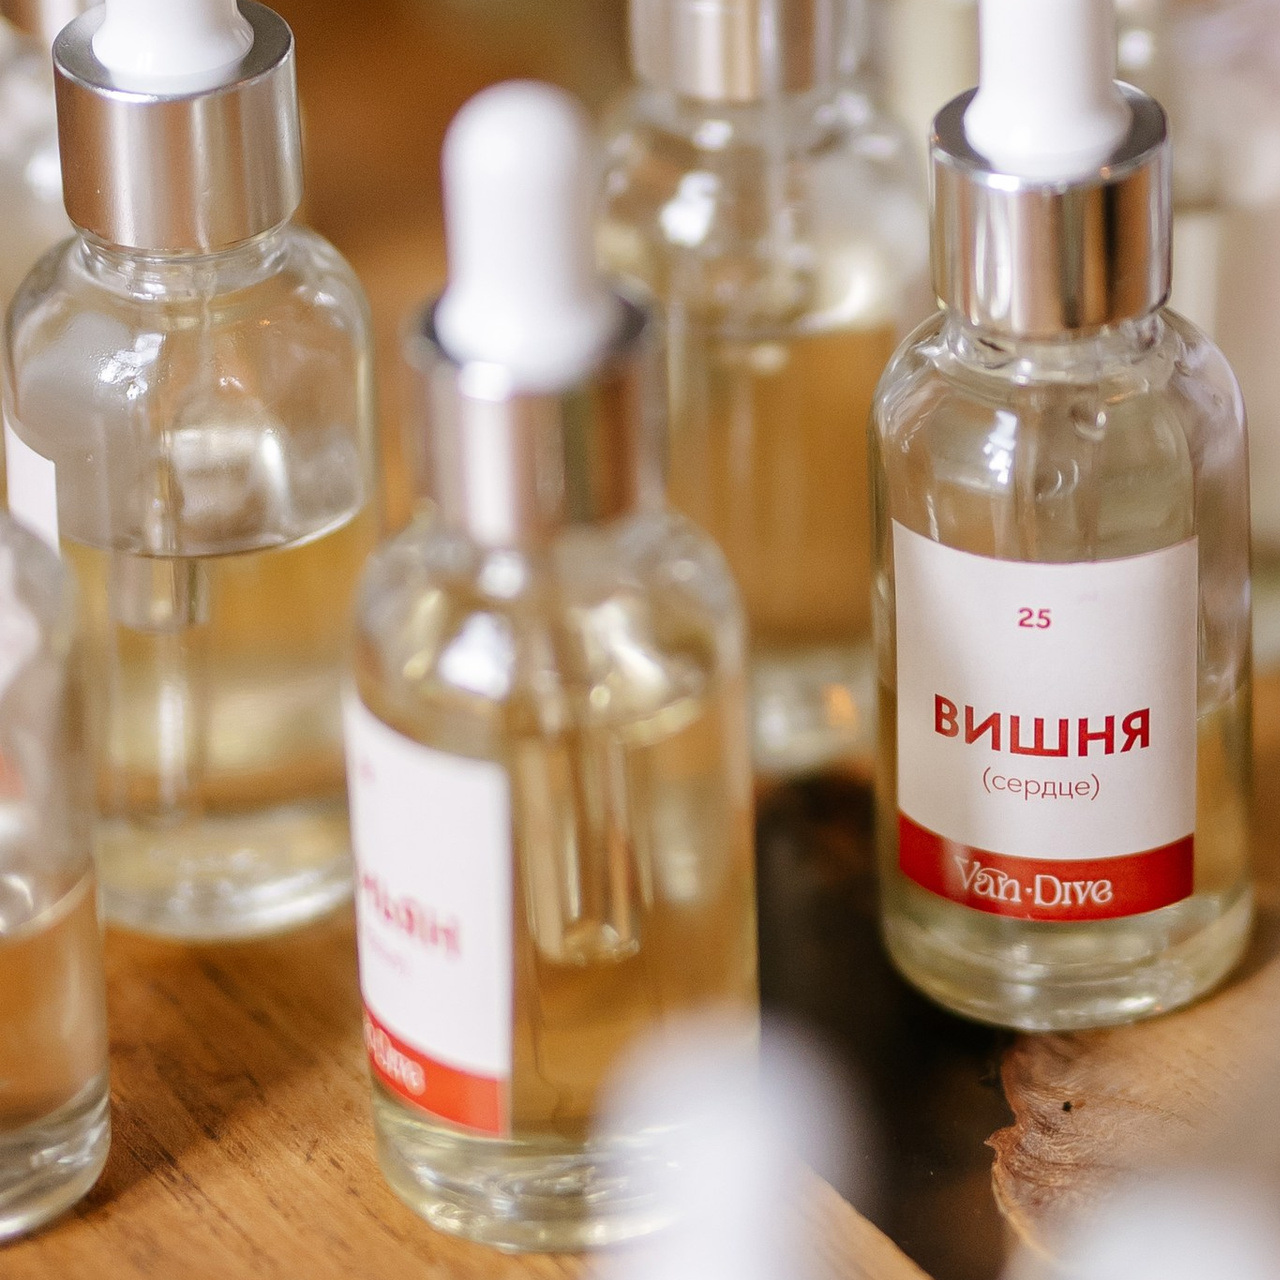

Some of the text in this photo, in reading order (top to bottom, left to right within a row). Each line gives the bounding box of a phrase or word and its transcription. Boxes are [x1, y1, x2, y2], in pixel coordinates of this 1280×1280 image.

[1018, 607, 1052, 629] 25
[934, 693, 1150, 758] ВИШНЯ
[982, 766, 1100, 801] (сердце)
